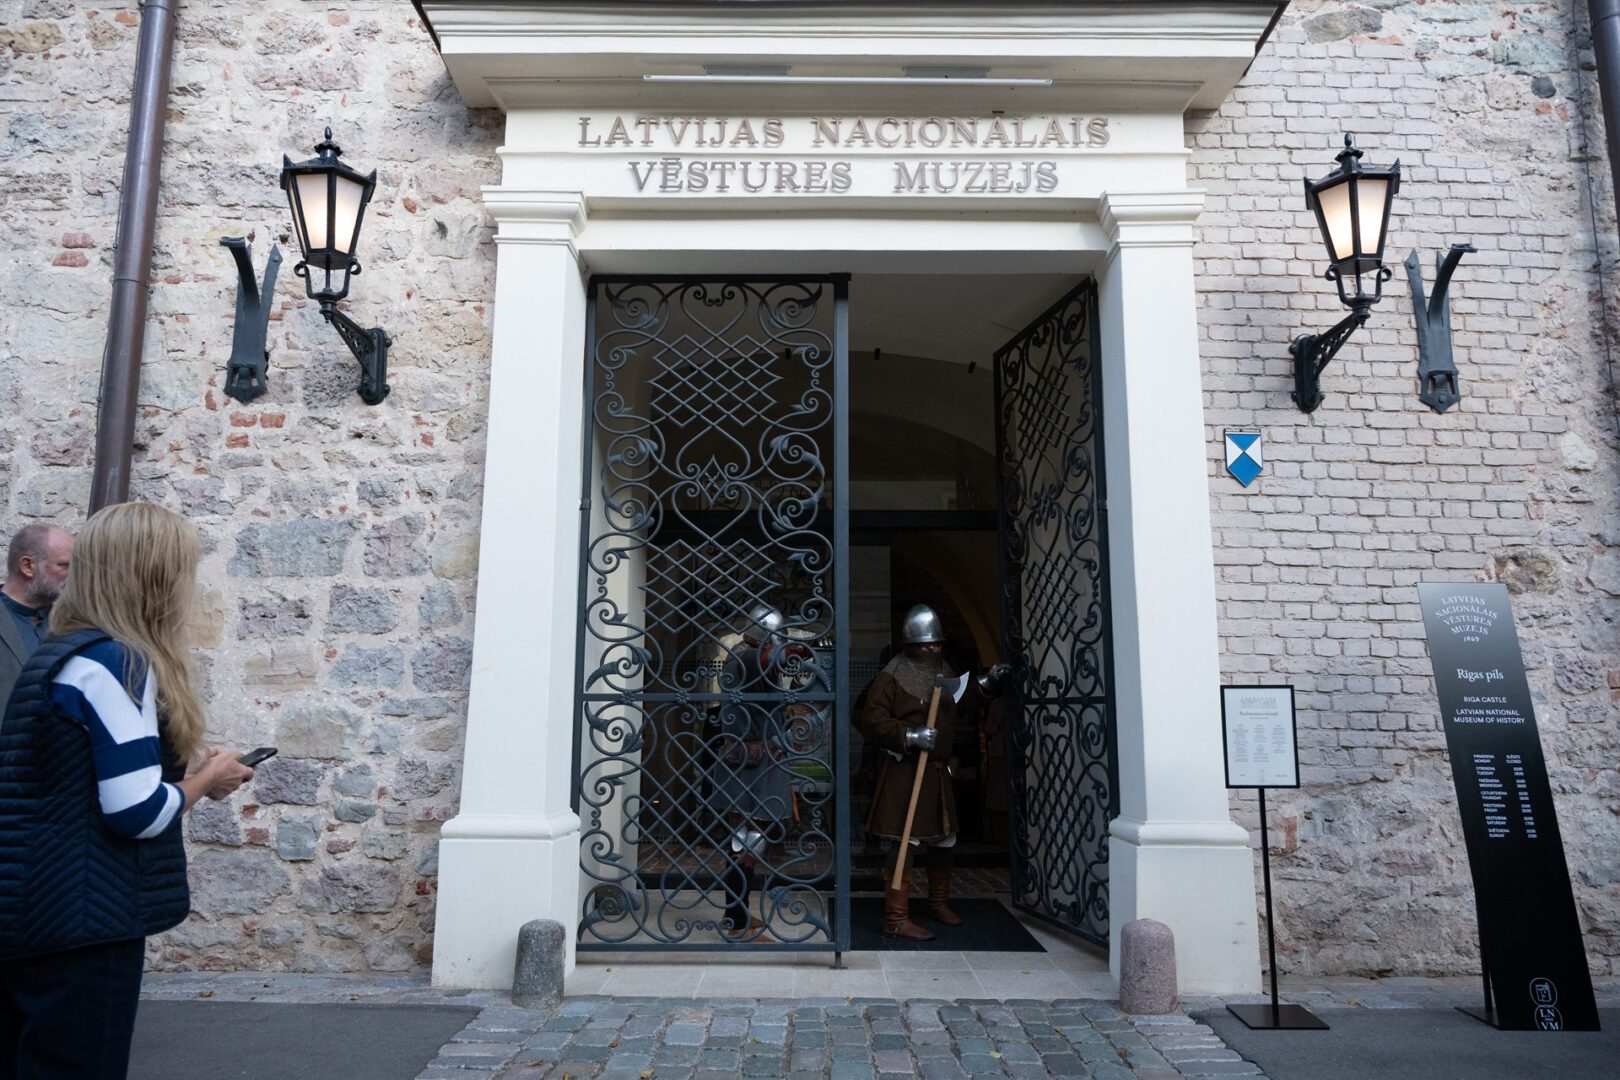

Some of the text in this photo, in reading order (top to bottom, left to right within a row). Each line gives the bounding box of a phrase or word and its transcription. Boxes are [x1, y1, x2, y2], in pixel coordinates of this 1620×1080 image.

[578, 110, 1111, 148] LATVIJAS NACIONĀLAIS
[628, 157, 1059, 193] VĒSTURES MUZEJS
[1441, 595, 1486, 605] LATVIJAS
[1451, 624, 1488, 635] MUZEJS
[1457, 668, 1504, 682] Rīgas pils
